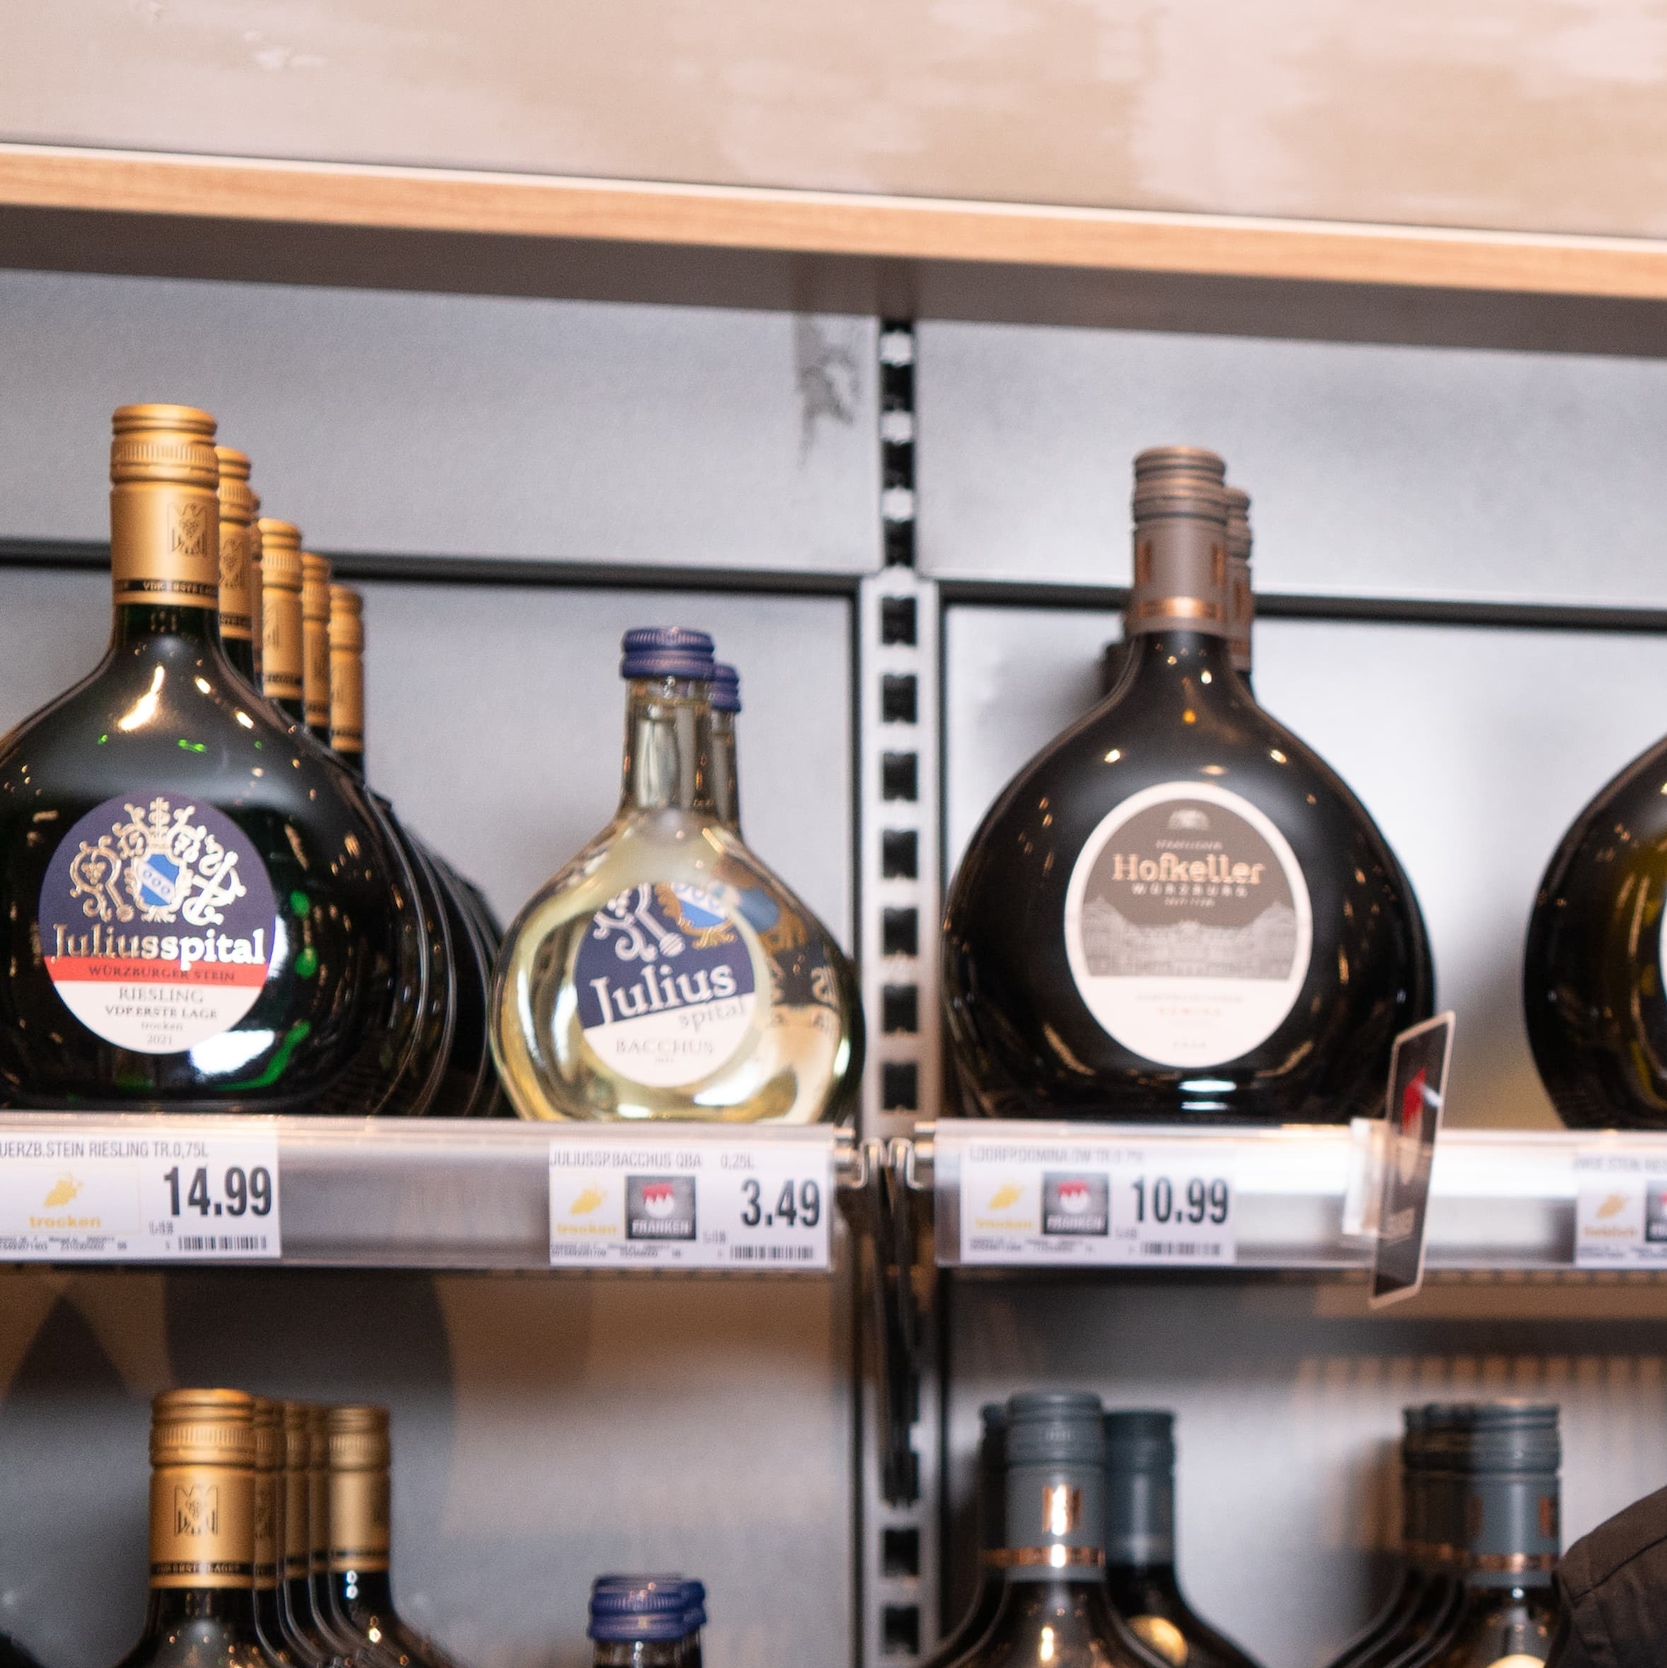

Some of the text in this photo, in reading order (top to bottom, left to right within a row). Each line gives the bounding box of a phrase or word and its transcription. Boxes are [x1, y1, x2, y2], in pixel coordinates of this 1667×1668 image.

[1112, 852, 1266, 884] Hofkeller
[51, 922, 267, 971] Juliusspital
[88, 965, 235, 981] WÜRZBURGER STEIN
[119, 986, 204, 1004] RIESLING
[182, 1007, 217, 1019] LAGE
[589, 964, 738, 1025] Julius
[678, 995, 746, 1034] spital
[89, 1142, 149, 1158] RIESLING
[164, 1166, 272, 1216] 14.99
[741, 1178, 821, 1227] 3.49
[1132, 1176, 1229, 1224] 10.99
